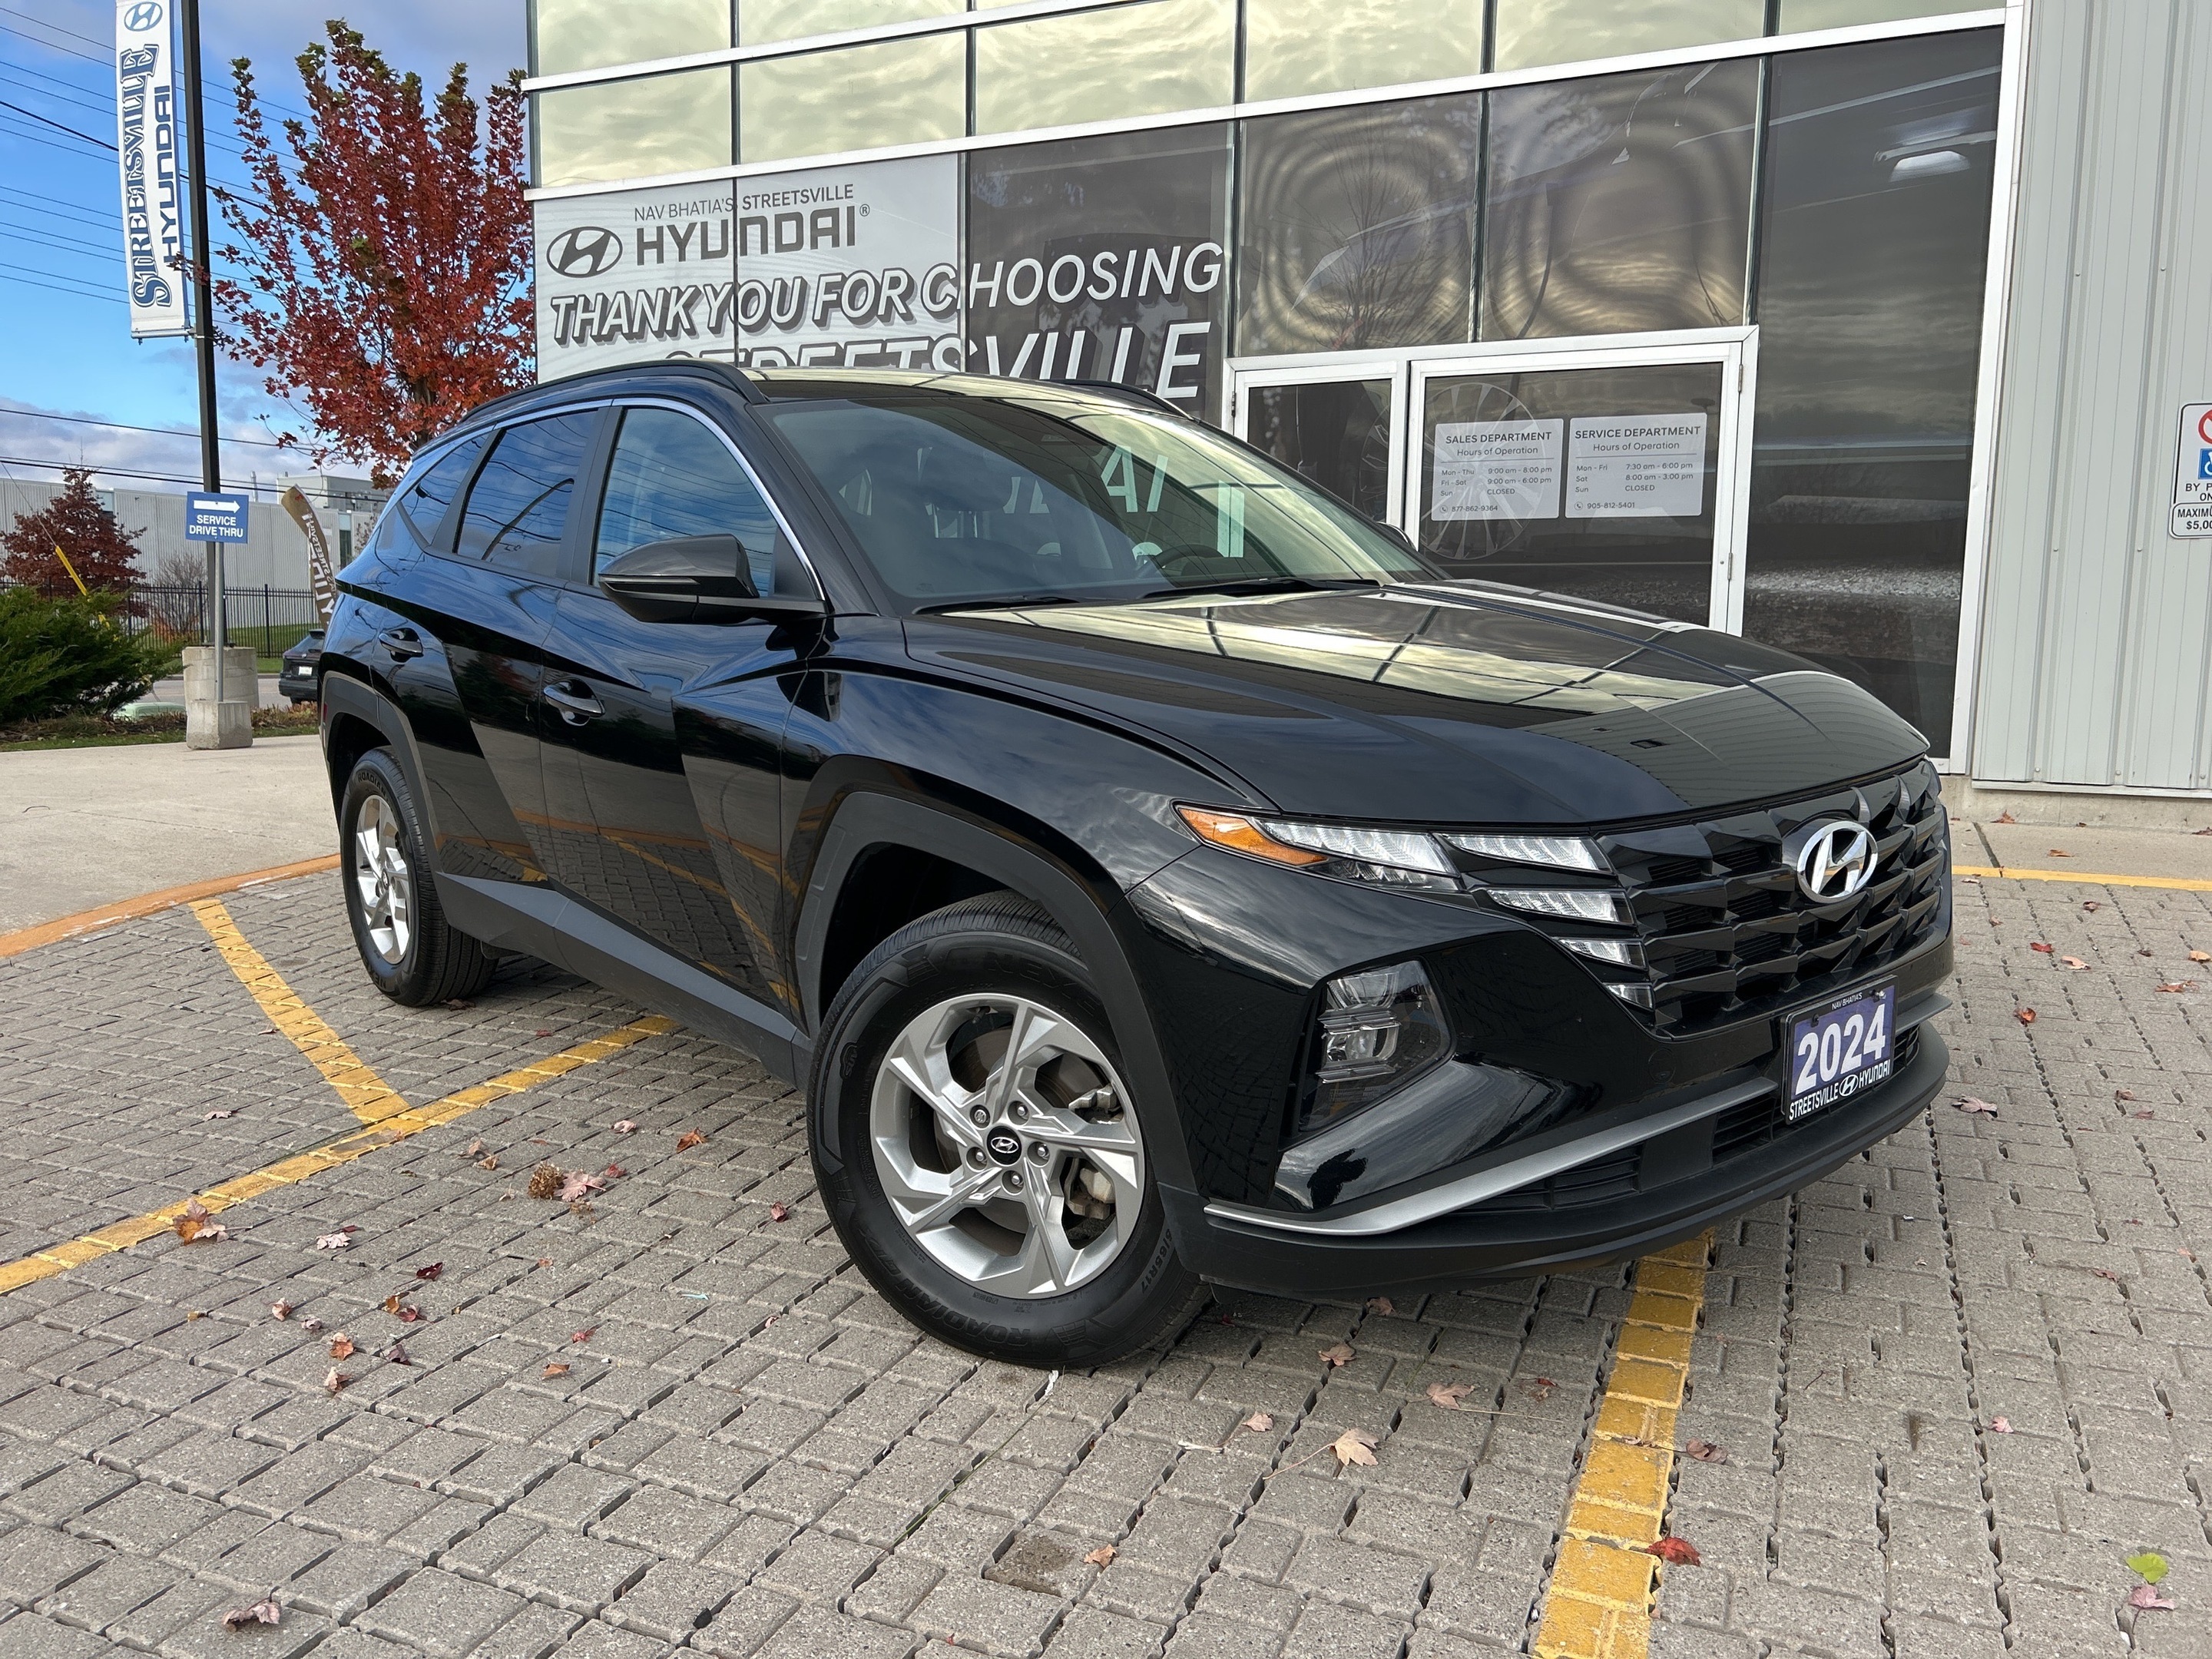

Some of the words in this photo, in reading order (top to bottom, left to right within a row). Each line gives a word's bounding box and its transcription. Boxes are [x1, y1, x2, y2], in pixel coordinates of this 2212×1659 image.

[120, 44, 173, 307] STREETSVILLE
[154, 85, 178, 263] HYUNDAI
[634, 204, 667, 222] NAV
[668, 197, 733, 219] BHATIA'S
[742, 184, 854, 210] STREETSVILLE
[550, 285, 700, 346] THANK
[702, 275, 810, 336] YOU
[812, 267, 920, 330] FOR
[921, 241, 1224, 318] CHOOSING
[1445, 435, 1478, 444] SALES
[1480, 432, 1551, 442] DEPARTMENT
[1575, 429, 1621, 439] SERVICE
[1624, 426, 1700, 437] DEPARTMENT
[1495, 447, 1538, 456] Operation
[1634, 442, 1679, 451] Operation
[2185, 483, 2200, 492] BY
[197, 514, 237, 526] SERVICE
[189, 525, 217, 536] DRIVE
[218, 526, 243, 538] THRU
[1832, 1000, 1843, 1010] NAV
[1795, 1003, 1886, 1096] 2024
[1789, 1082, 1839, 1121] STREETSVILLE
[1859, 1059, 1891, 1089] HYUNDAI
